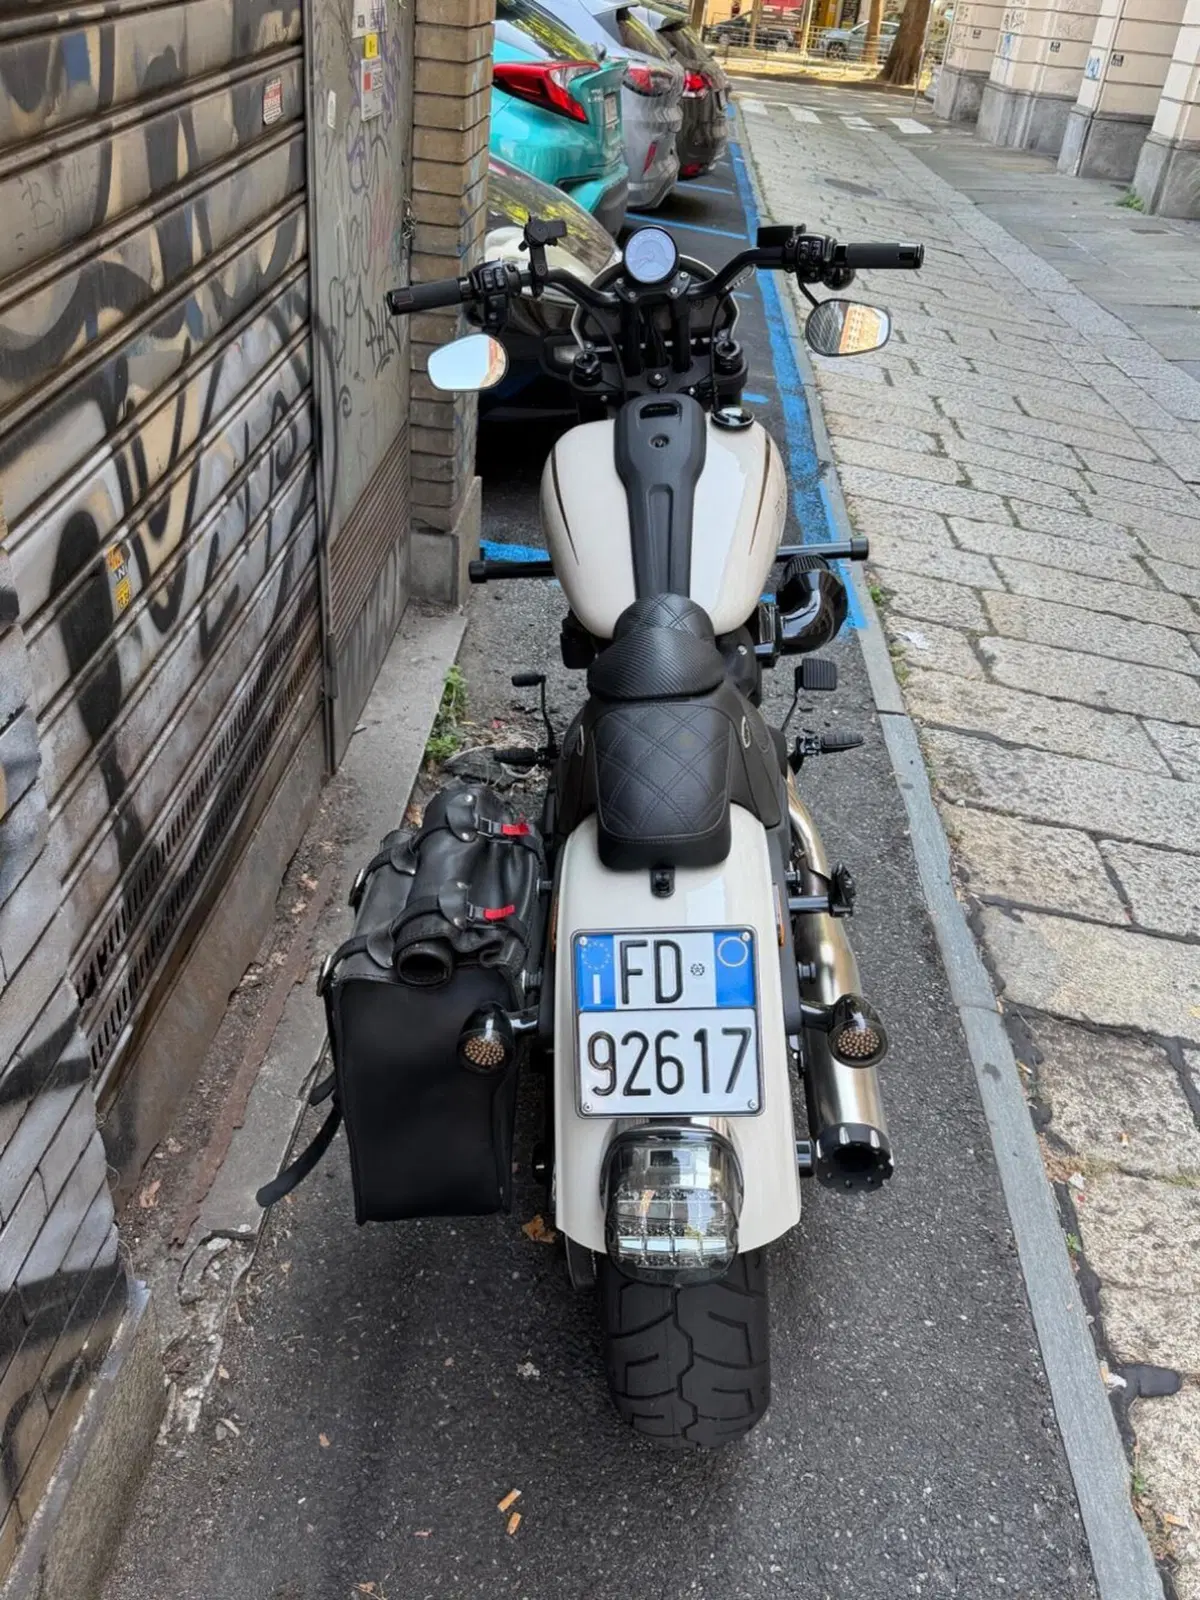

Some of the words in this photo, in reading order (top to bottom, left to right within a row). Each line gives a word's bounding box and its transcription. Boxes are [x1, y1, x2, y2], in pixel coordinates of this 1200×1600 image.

[593, 974, 601, 1004] I
[619, 939, 684, 1005] FD
[587, 1027, 752, 1096] 92617
